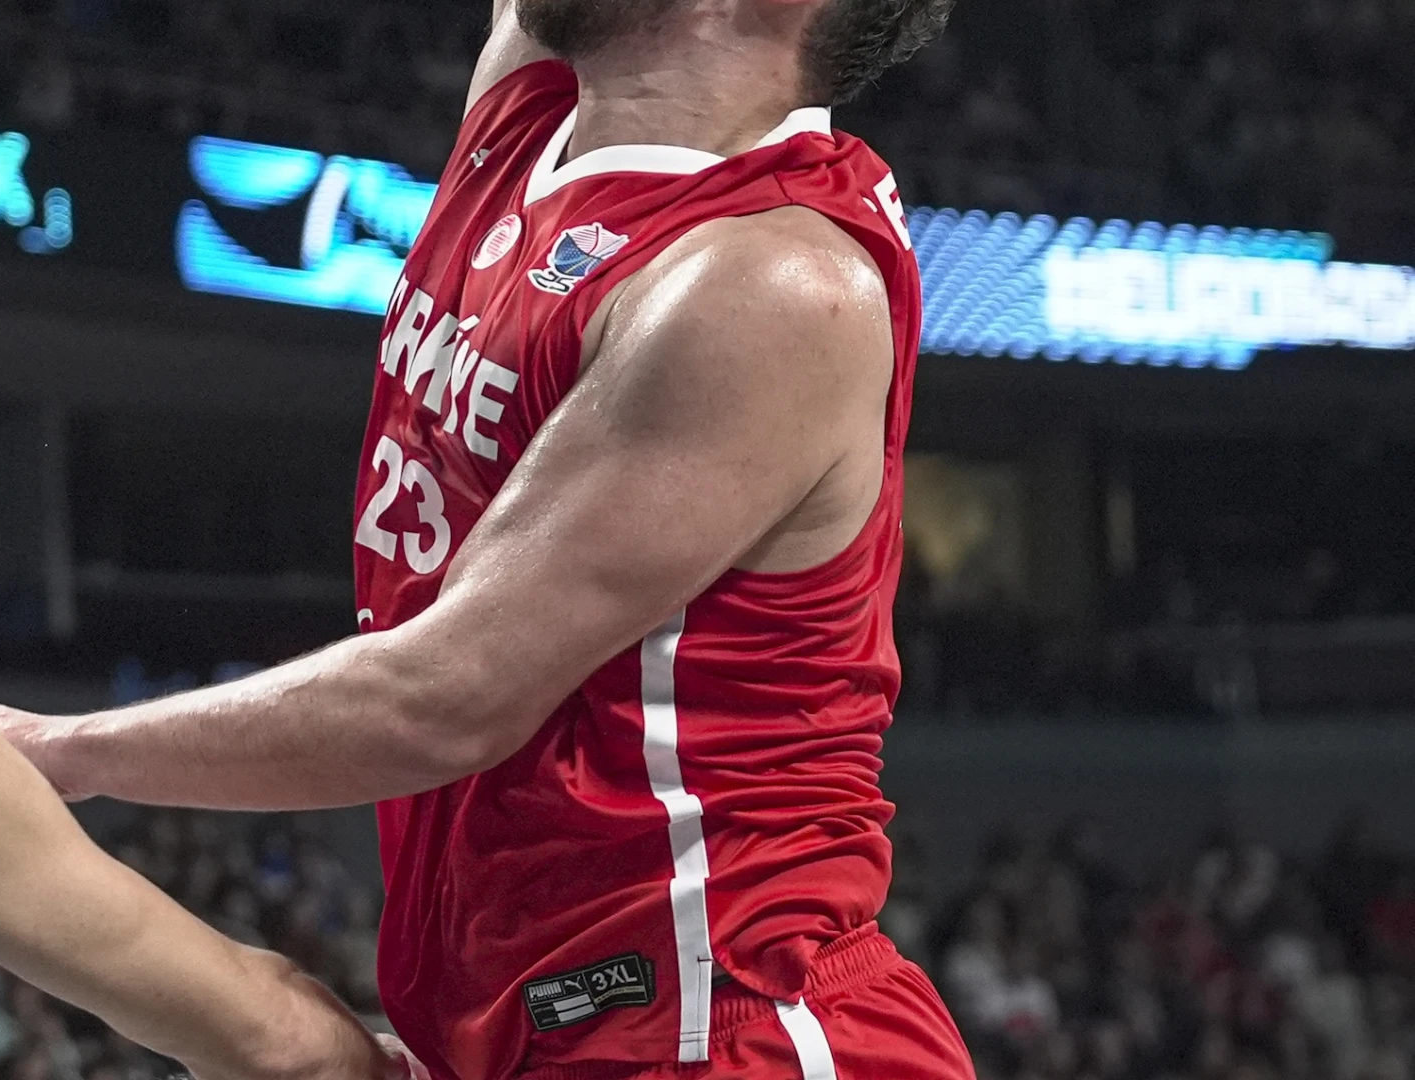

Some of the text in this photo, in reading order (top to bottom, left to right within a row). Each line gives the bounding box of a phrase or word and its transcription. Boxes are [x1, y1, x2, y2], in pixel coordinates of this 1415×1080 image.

[354, 434, 452, 575] 23
[528, 980, 562, 999] PUMA
[591, 964, 639, 991] 3XL
